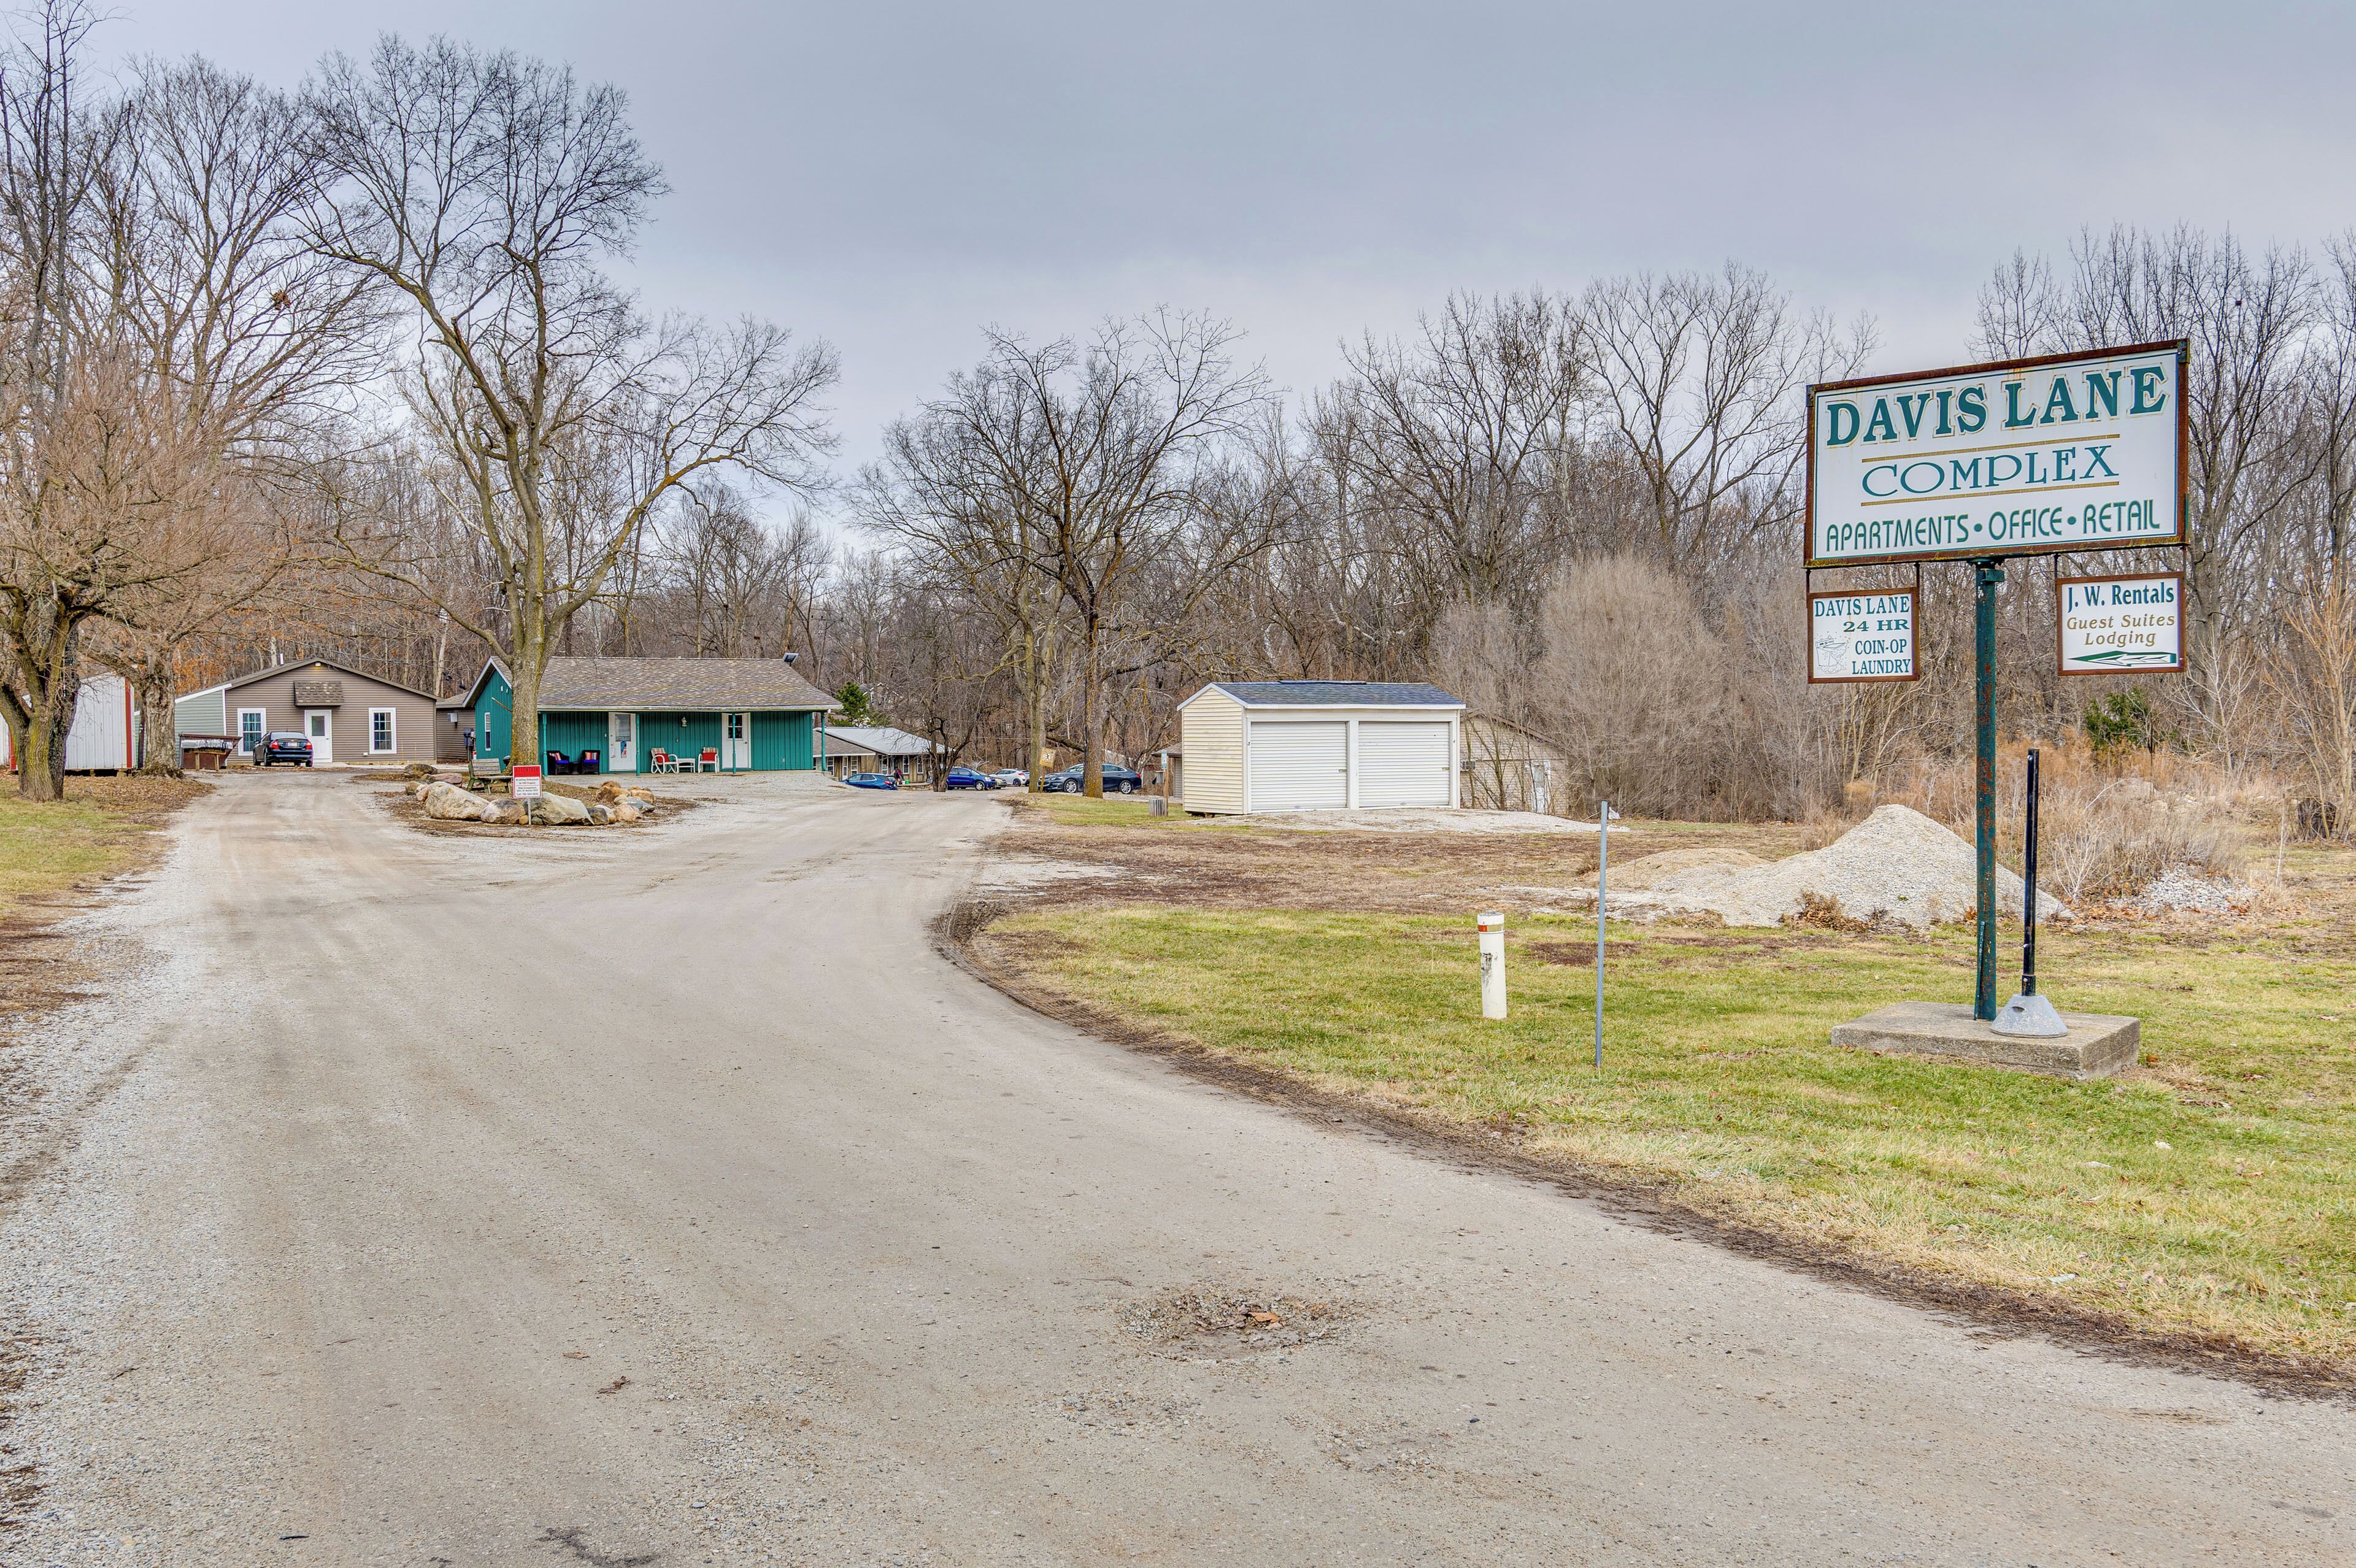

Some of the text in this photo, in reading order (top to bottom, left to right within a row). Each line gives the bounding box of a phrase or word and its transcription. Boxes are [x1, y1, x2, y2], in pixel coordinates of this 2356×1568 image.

[1826, 364, 2168, 447] DAVIS LANE
[1862, 445, 2119, 496] COMPLEX
[1826, 499, 2160, 551] APARTMENTS OFFICE RETAIL
[1815, 596, 1909, 617] DAVIS LANE
[2068, 582, 2174, 613] J. W. Rentals
[1844, 620, 1909, 632] 24 HR
[2067, 614, 2175, 630] Guest Suites
[1855, 639, 1907, 655] COIN-OP
[2085, 631, 2156, 648] Lodging
[1852, 659, 1911, 674] LAUNDRY
